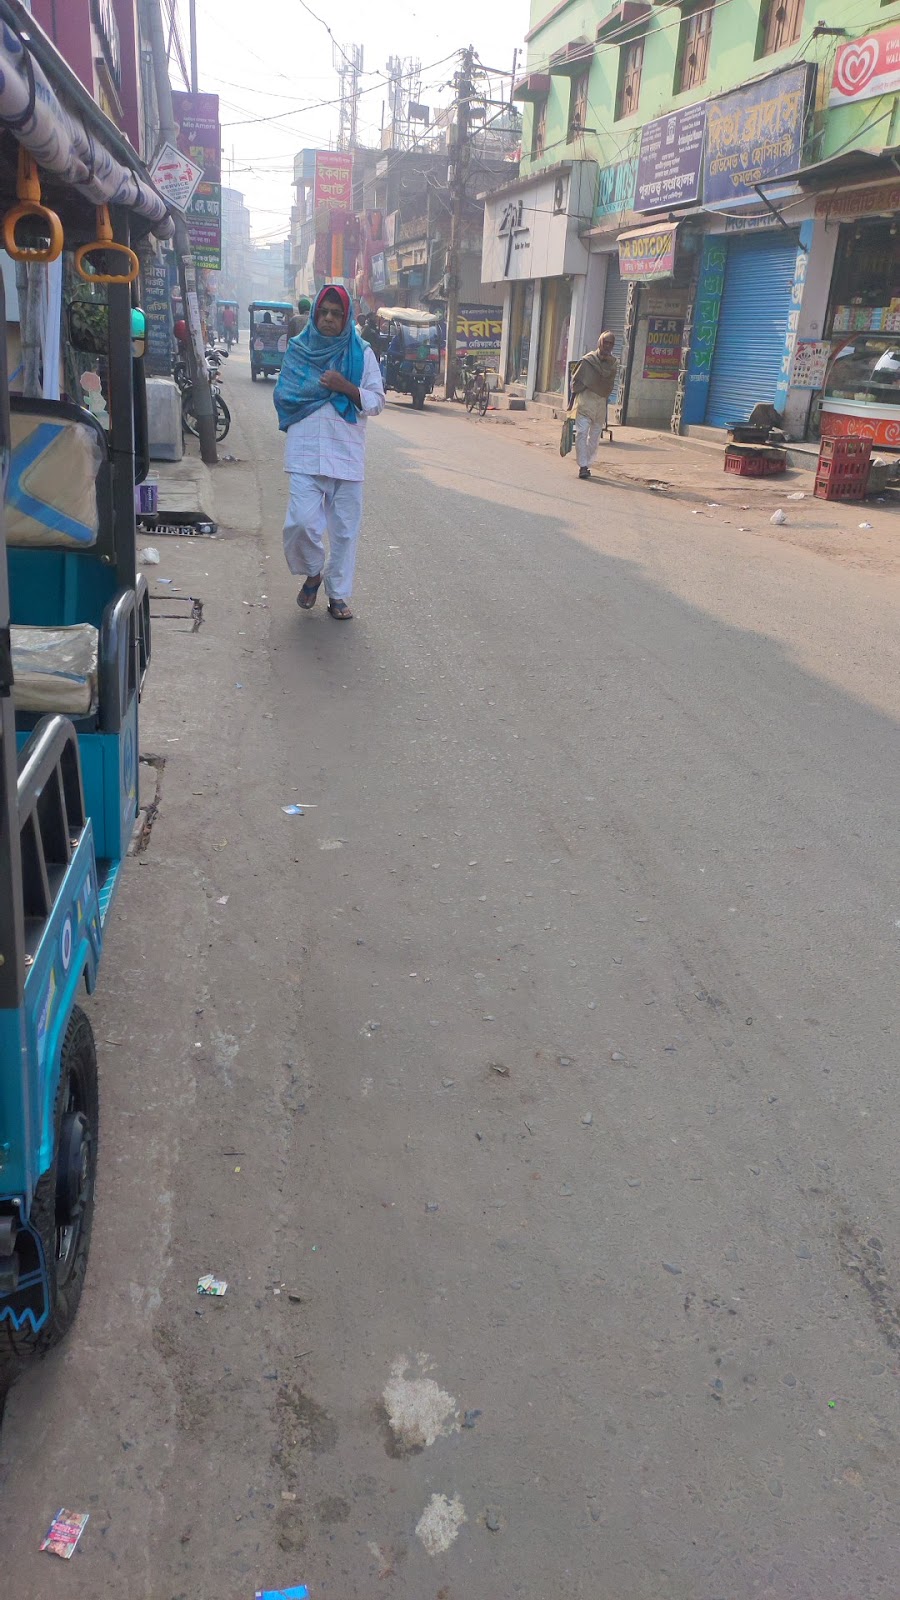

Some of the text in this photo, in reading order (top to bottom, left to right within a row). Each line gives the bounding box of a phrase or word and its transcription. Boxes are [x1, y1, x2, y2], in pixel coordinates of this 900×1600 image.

[161, 181, 189, 190] SERVICE
[632, 233, 672, 257] DOTCOM
[654, 319, 677, 332] F.R
[648, 332, 681, 345] DOTCOM
